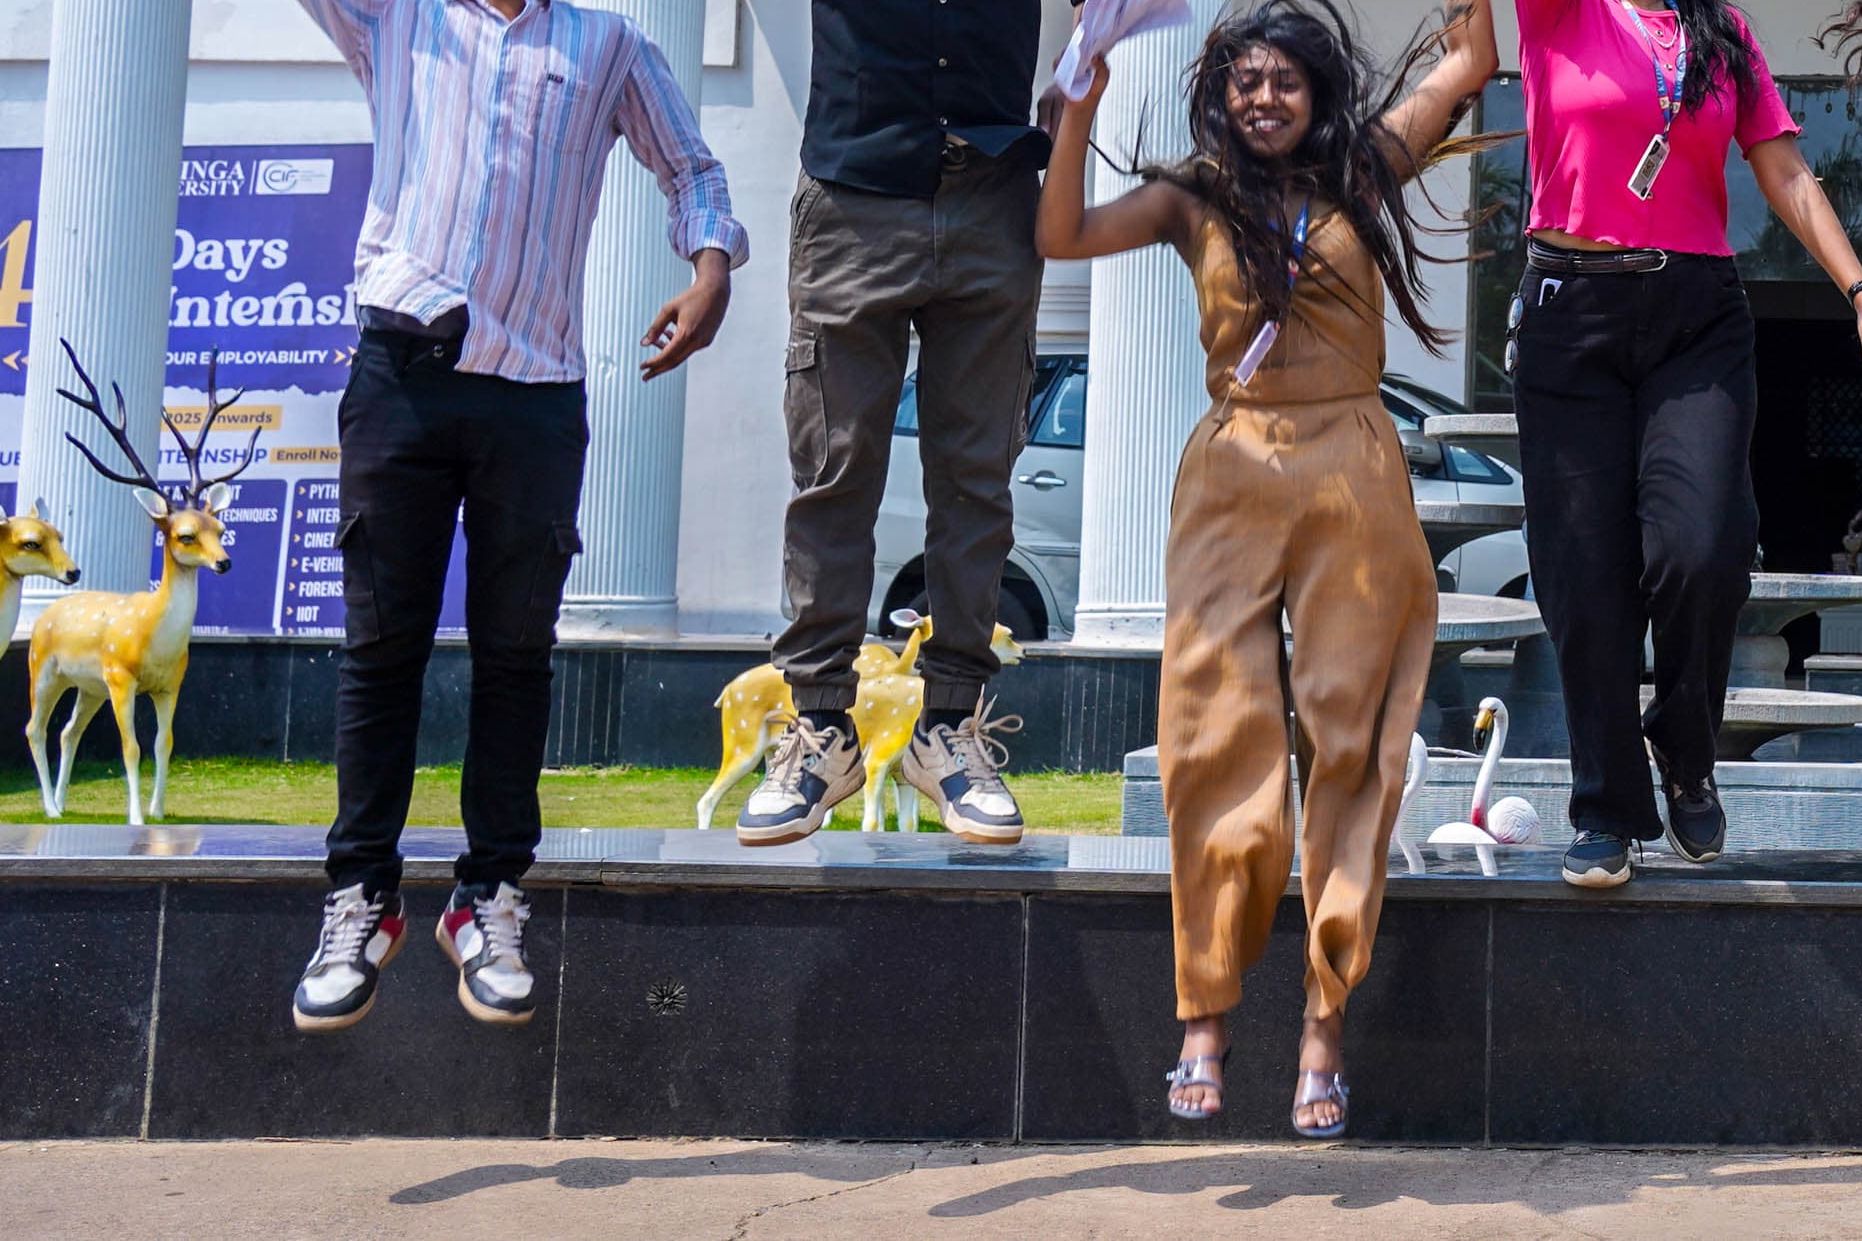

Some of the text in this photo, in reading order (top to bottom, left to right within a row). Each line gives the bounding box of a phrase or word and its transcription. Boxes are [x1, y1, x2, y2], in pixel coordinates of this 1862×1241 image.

[180, 160, 245, 180] INGA
[178, 180, 246, 196] ERSITY
[172, 228, 290, 283] Days
[165, 351, 197, 365] OUR
[217, 411, 272, 424] nwards
[158, 448, 268, 465] TENSHP
[276, 449, 341, 461] Enroll No
[309, 483, 340, 500] PYTH
[306, 508, 341, 524] INTER
[298, 580, 344, 597] FORENS
